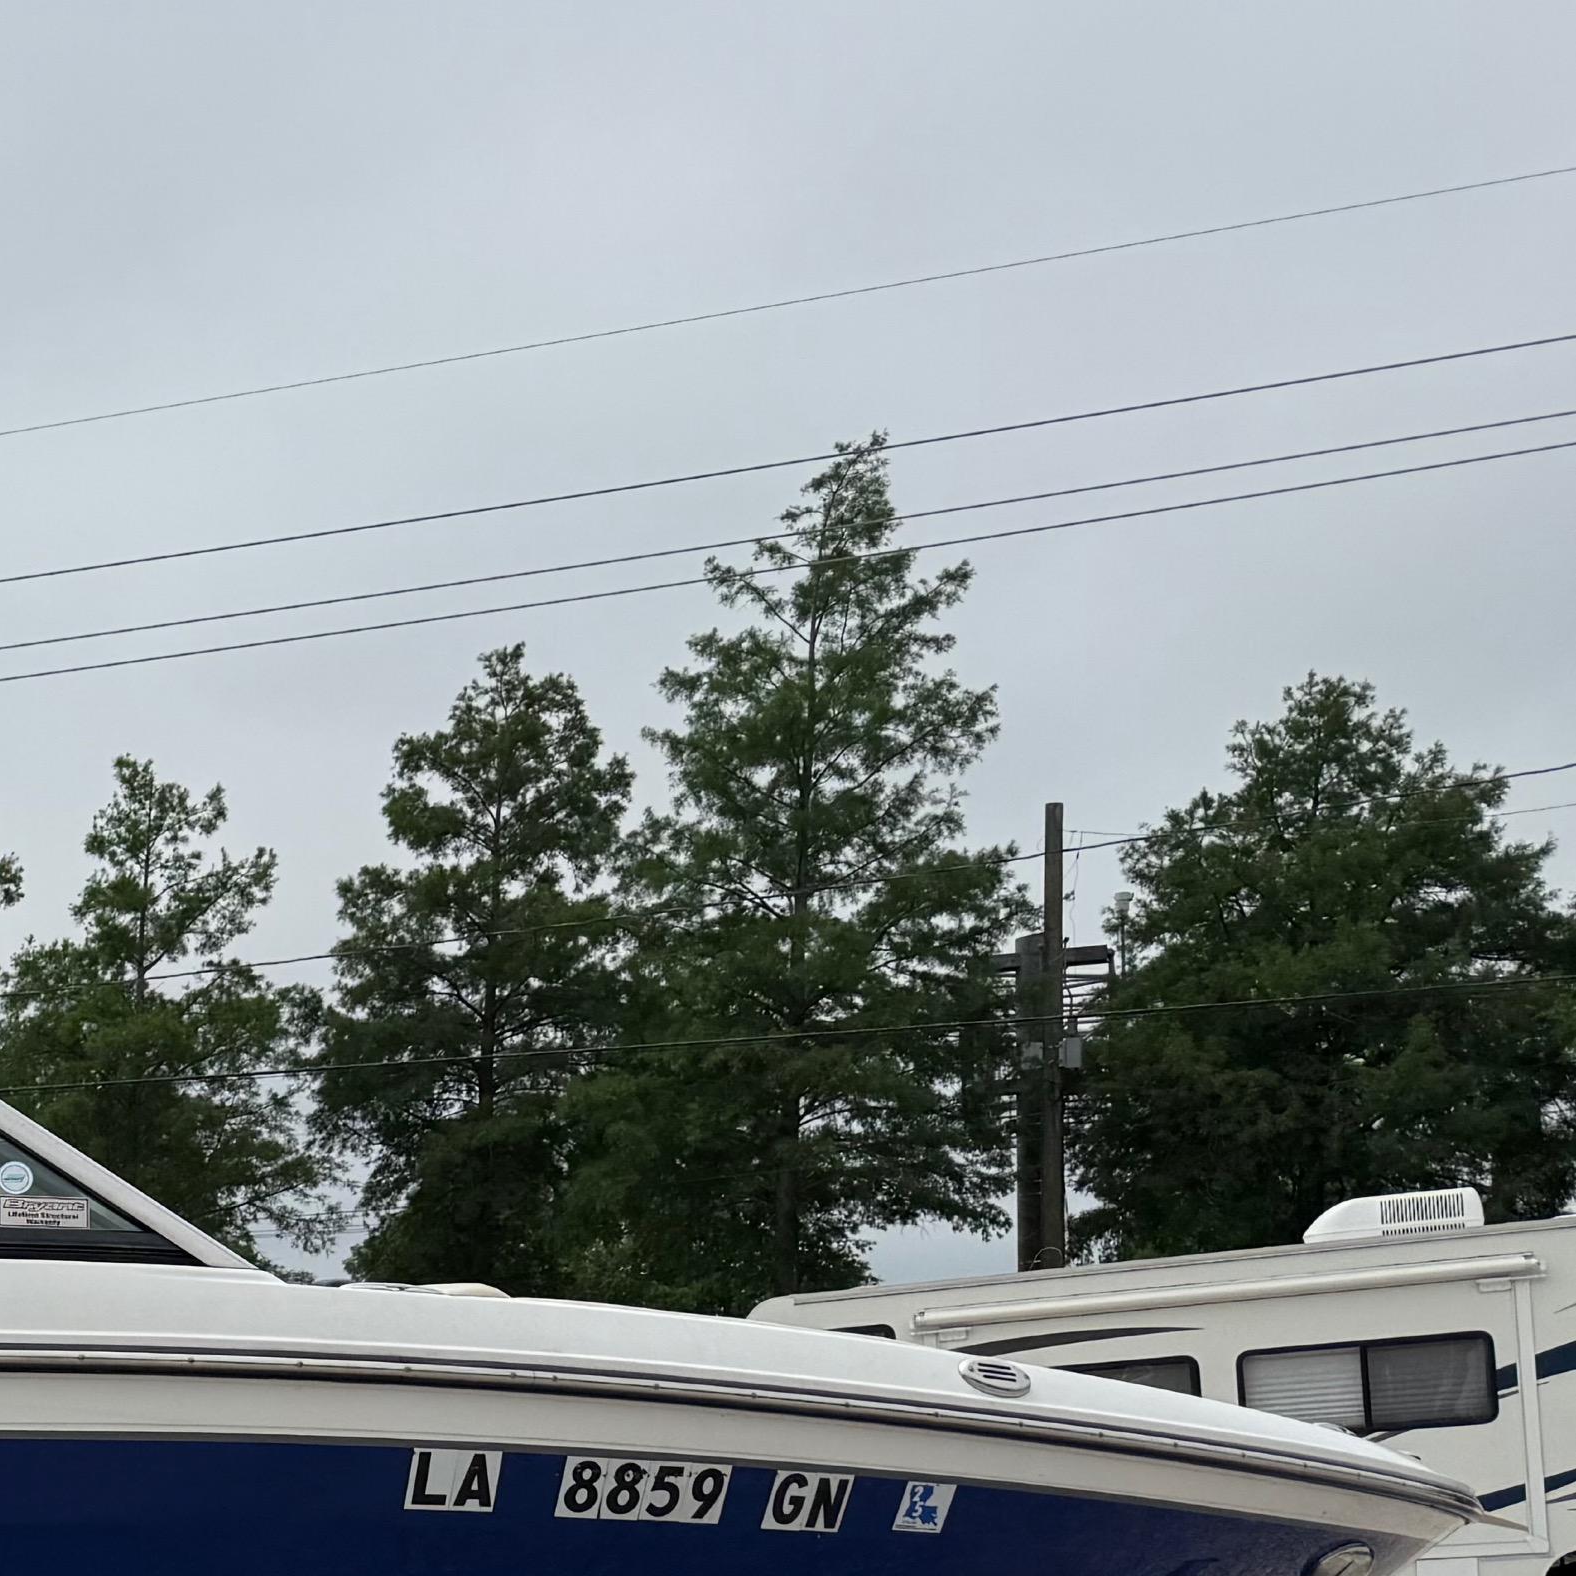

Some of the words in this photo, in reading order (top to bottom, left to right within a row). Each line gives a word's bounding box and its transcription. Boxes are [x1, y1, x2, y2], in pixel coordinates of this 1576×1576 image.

[411, 1451, 493, 1507] LA
[563, 1460, 726, 1520] 8859
[771, 1472, 849, 1529] GN
